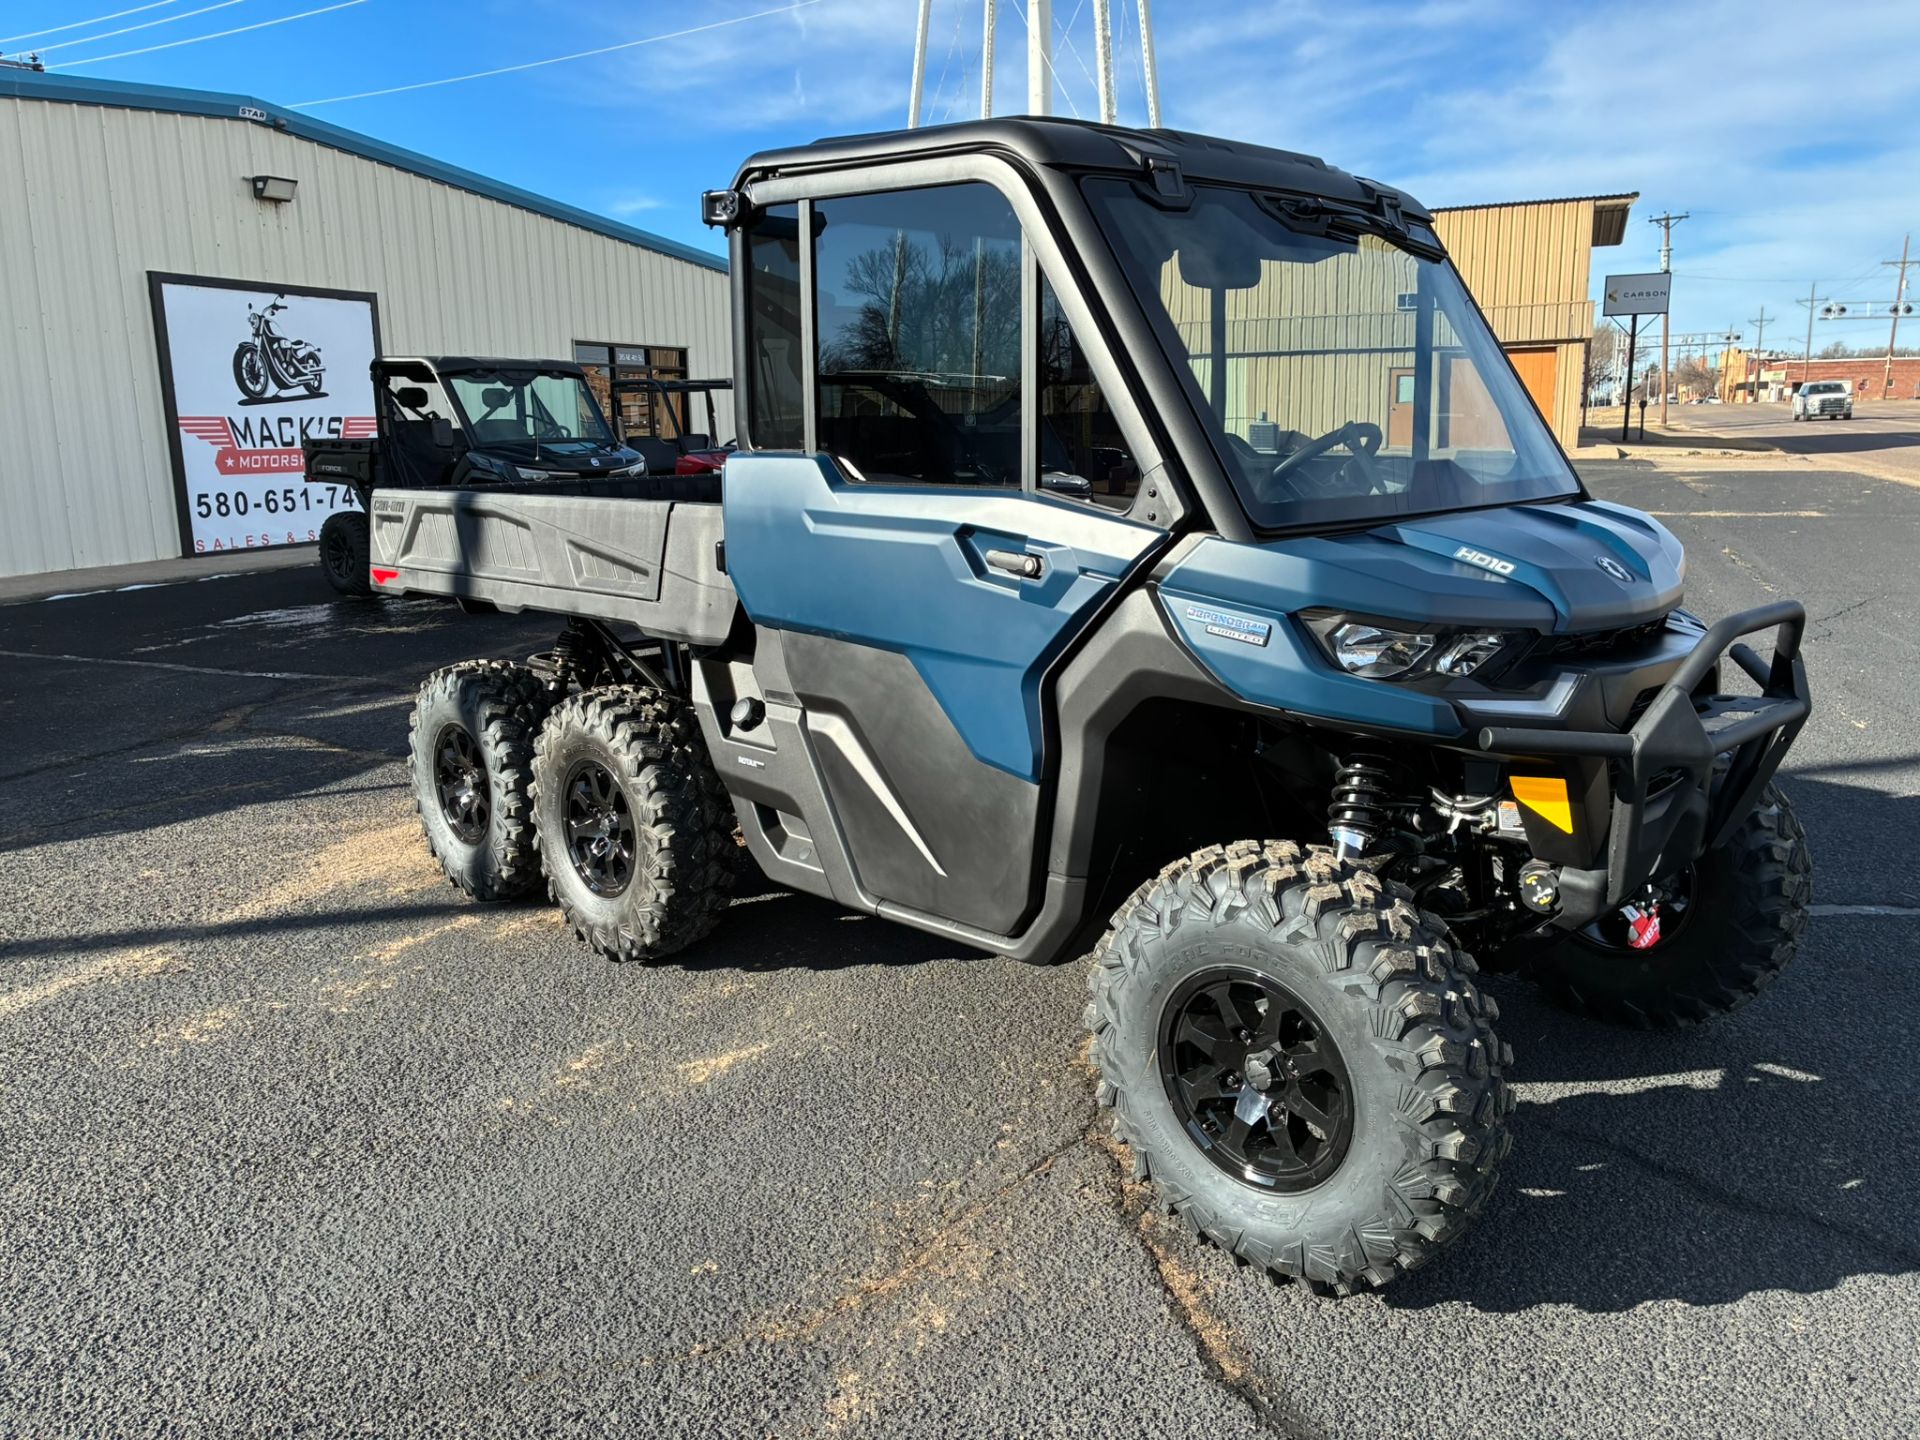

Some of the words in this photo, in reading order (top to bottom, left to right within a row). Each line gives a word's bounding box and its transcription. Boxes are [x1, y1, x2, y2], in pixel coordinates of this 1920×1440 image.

[241, 108, 265, 118] STAR
[1623, 290, 1667, 298] CARSON
[227, 416, 343, 448] MACK'S
[239, 454, 305, 468] MOTORS
[196, 533, 270, 551] SALES
[287, 531, 296, 544] &
[1453, 546, 1517, 573] HD10
